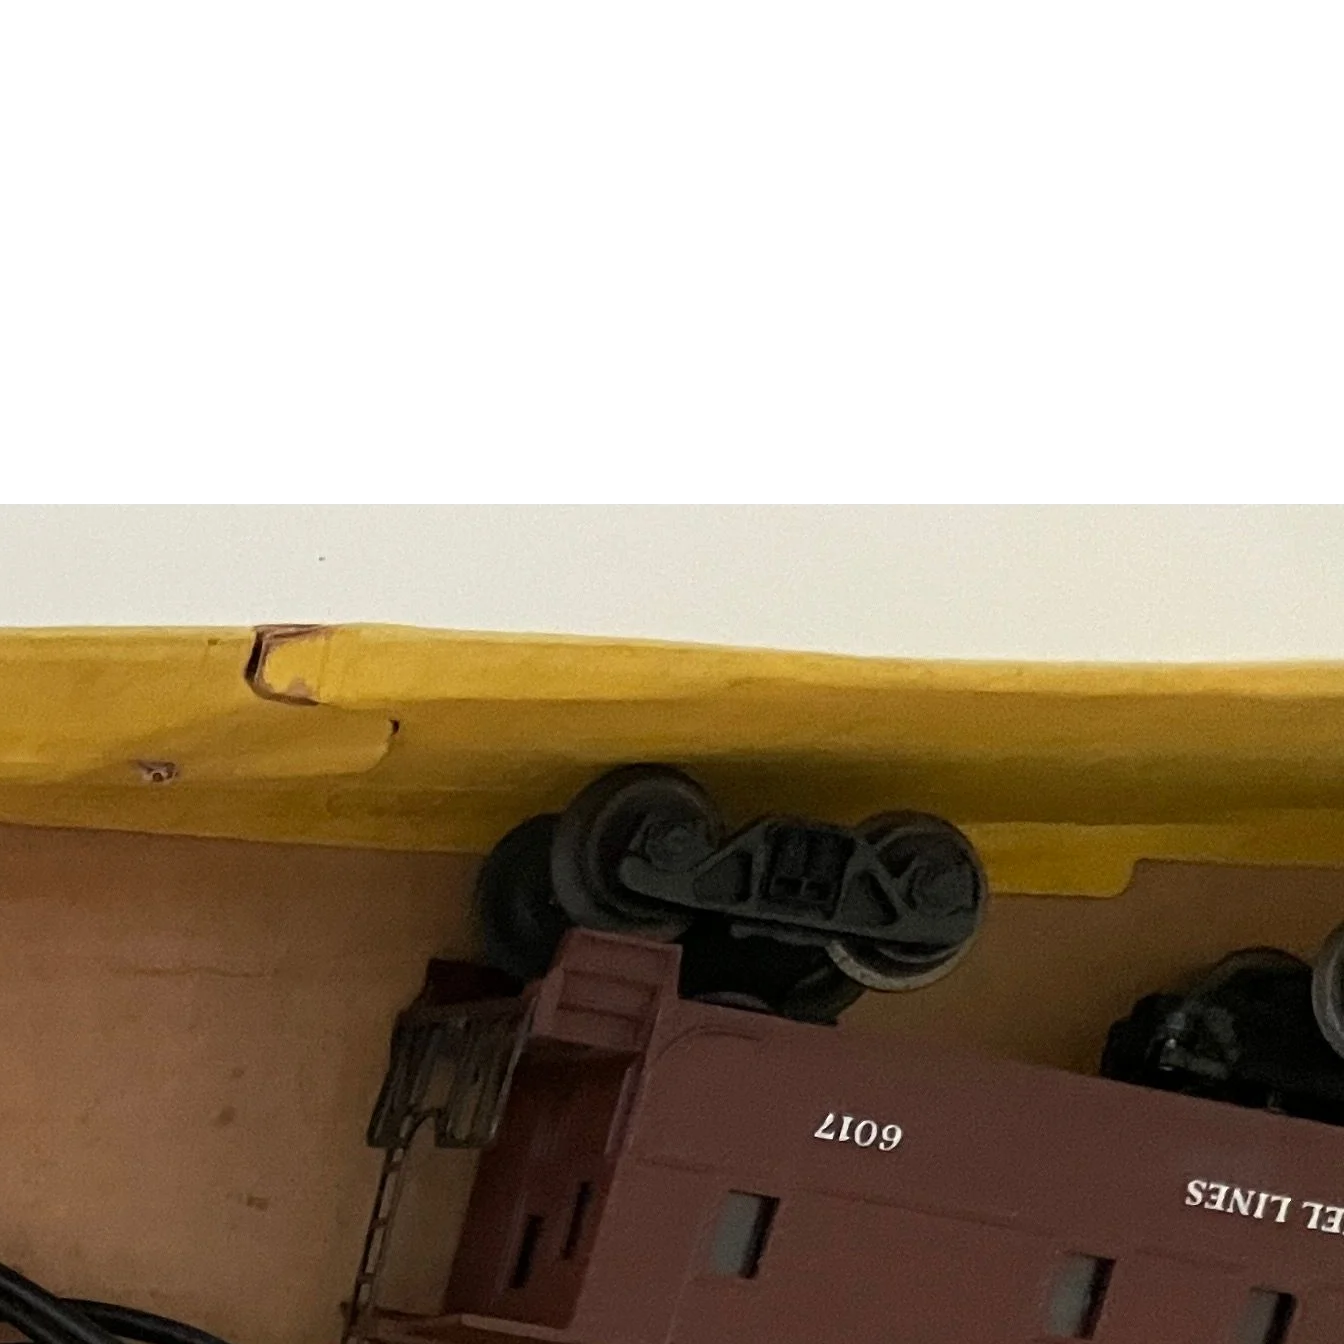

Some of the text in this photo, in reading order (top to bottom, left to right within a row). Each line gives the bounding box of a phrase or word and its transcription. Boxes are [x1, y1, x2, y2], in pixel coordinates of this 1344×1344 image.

[813, 1112, 902, 1151] 6017
[1185, 1179, 1344, 1234] EL LINES
